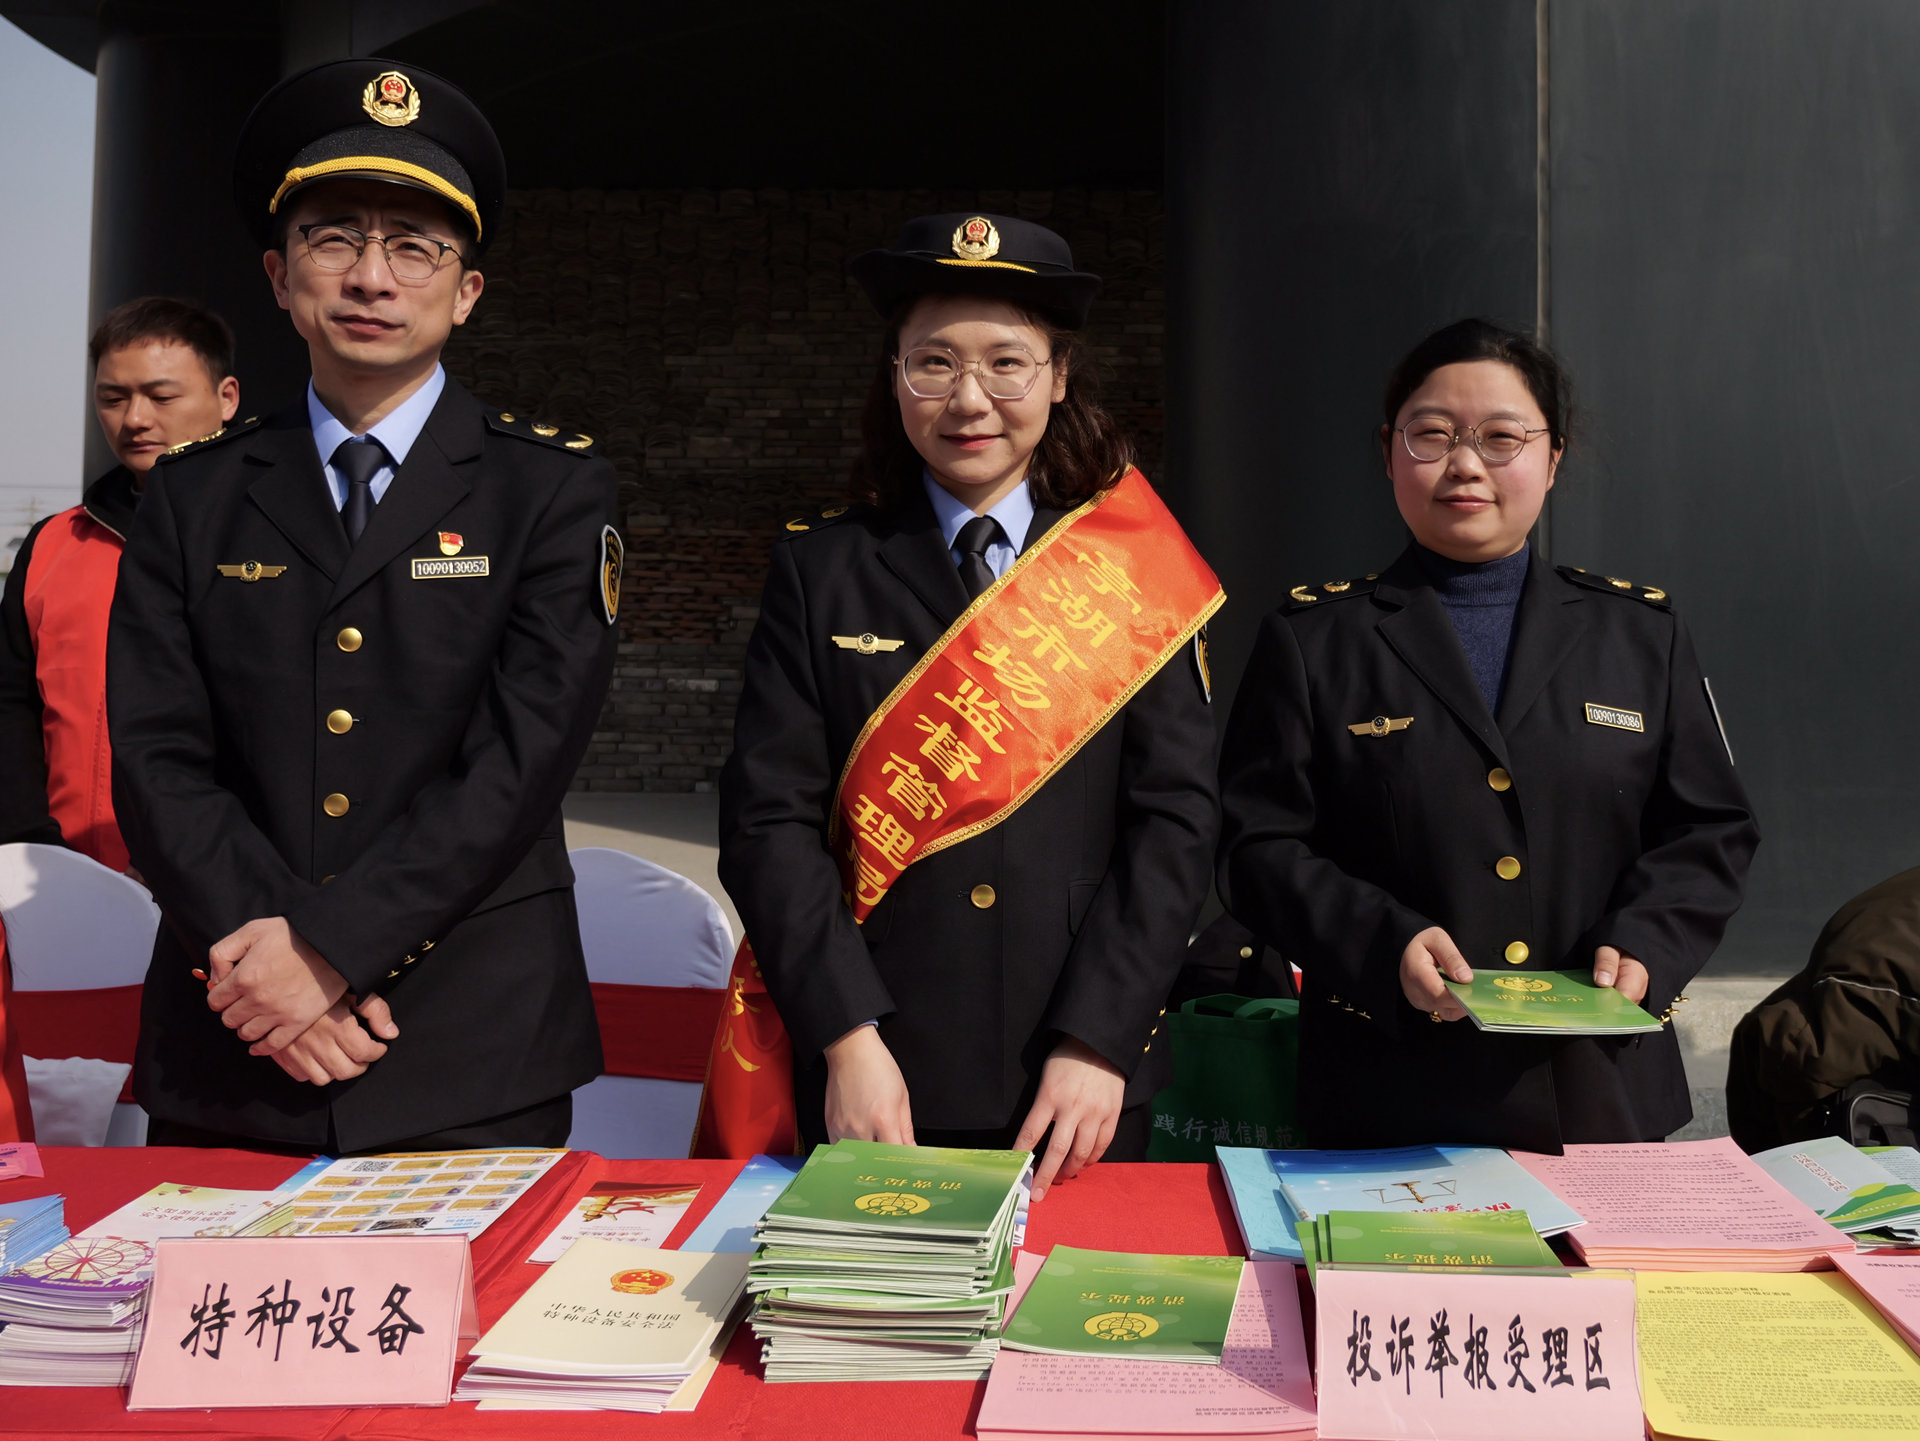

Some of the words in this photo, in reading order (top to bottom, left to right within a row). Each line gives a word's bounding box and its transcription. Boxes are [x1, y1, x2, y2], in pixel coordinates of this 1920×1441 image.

[416, 561, 486, 576] 10090130052
[846, 551, 1142, 906] 亭湖市场监督管理局
[179, 1278, 425, 1363] 特种设备
[543, 1310, 674, 1329] 特种设备安全法
[550, 1302, 682, 1321] 中华人民共和国
[1346, 1308, 1611, 1398] 投诉举报受理区
